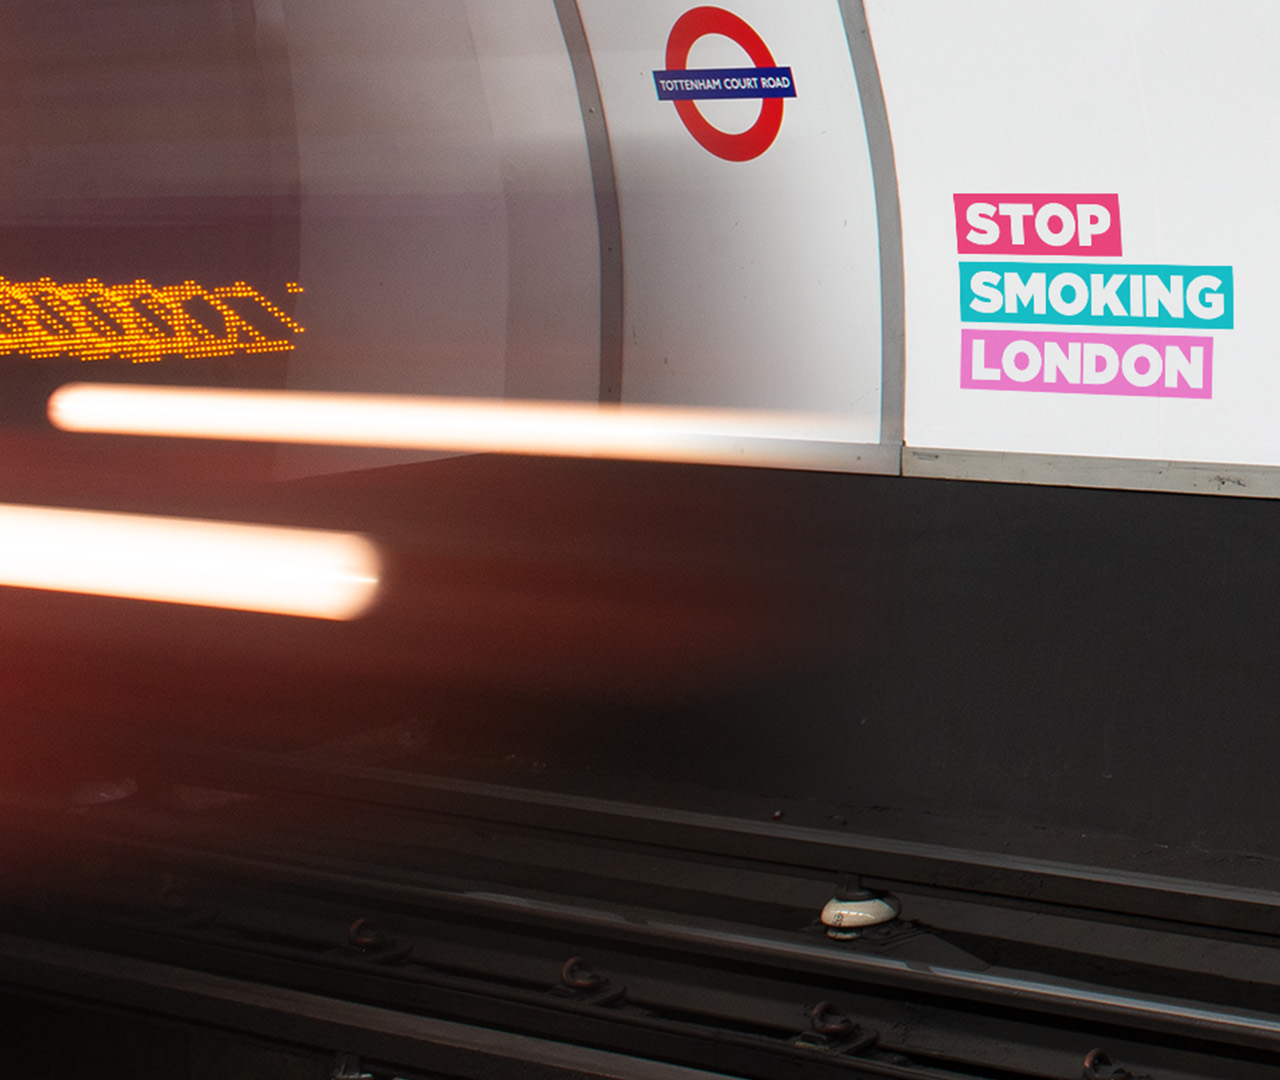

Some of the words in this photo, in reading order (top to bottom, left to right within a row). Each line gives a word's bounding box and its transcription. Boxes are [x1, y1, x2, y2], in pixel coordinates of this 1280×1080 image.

[659, 78, 722, 91] TOTTENHAM
[723, 77, 759, 90] COURT
[760, 76, 790, 89] ROAD
[966, 202, 1112, 247] STOP
[969, 270, 1225, 320] SMOKING
[971, 338, 1205, 390] LONDON
